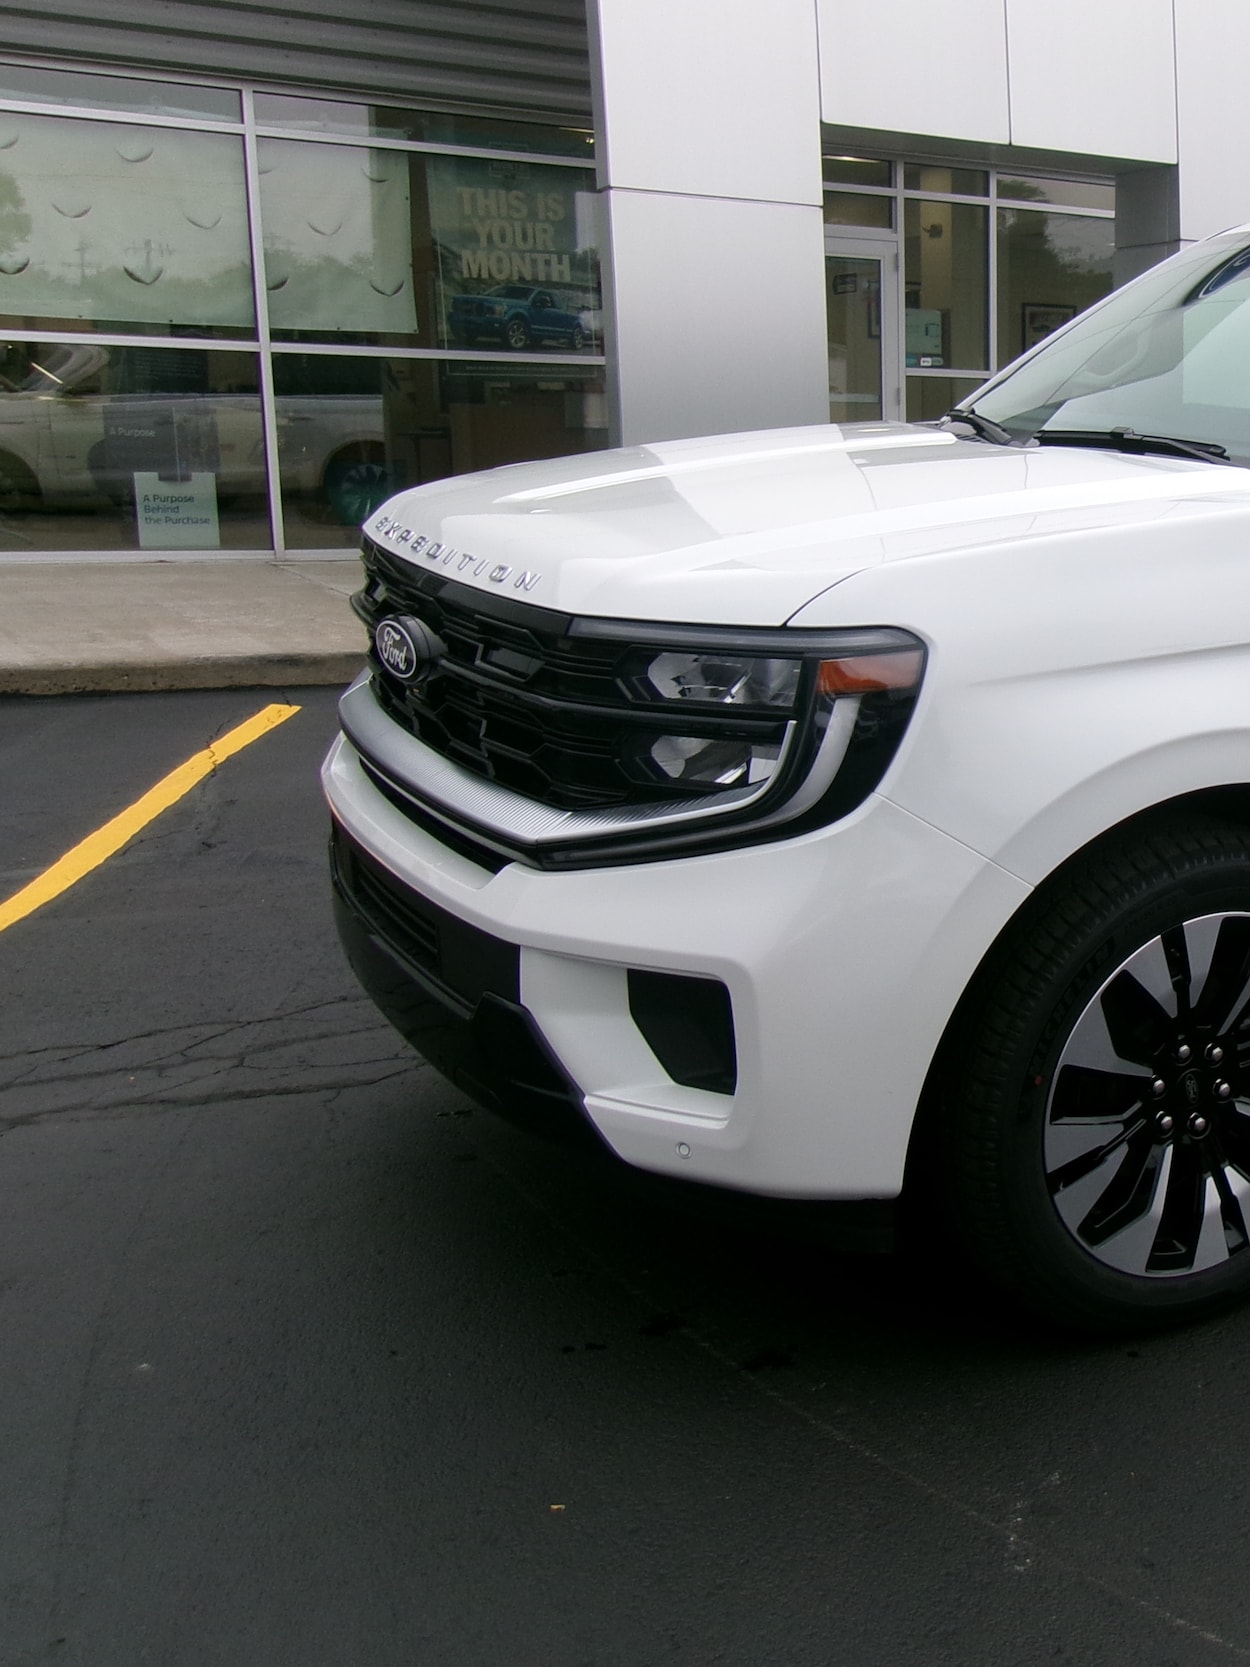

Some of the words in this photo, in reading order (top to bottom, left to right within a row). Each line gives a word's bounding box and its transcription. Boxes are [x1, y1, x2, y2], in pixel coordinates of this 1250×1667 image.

[456, 187, 528, 219] THIS
[537, 192, 565, 221] IS
[474, 219, 555, 250] YOUR
[461, 250, 571, 281] MONTH
[144, 494, 150, 503] A
[153, 494, 195, 505] Purpose
[144, 505, 180, 514] Behind
[145, 516, 161, 525] the
[164, 516, 210, 526] Purchase
[375, 517, 542, 591] EXPEDITION
[381, 626, 408, 671] Ford
